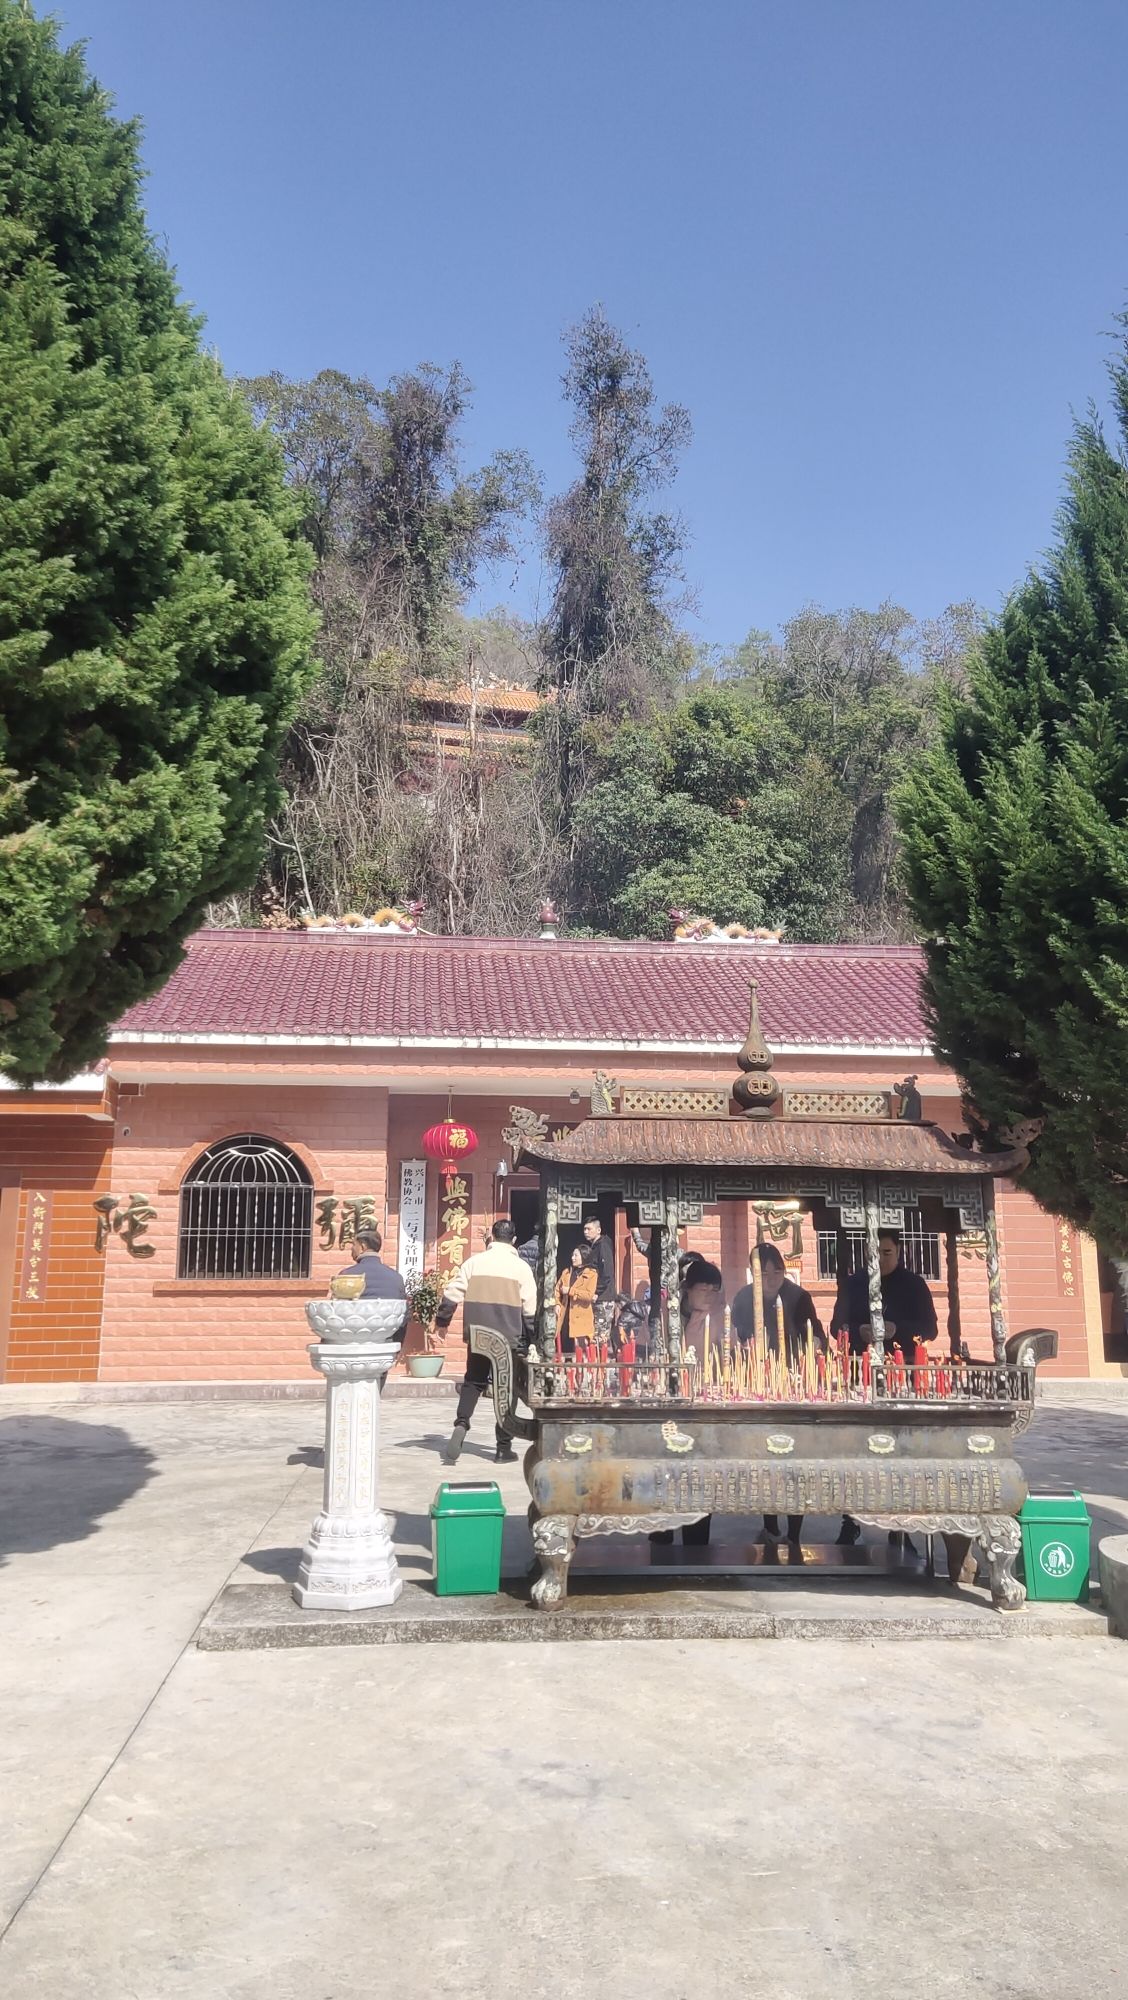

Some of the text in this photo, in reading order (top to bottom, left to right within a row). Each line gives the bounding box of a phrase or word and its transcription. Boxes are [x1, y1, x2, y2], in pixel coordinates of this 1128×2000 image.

[449, 1128, 469, 1149] 福
[403, 1168, 413, 1205] 佛教协会
[414, 1168, 425, 1206] 兴宁市
